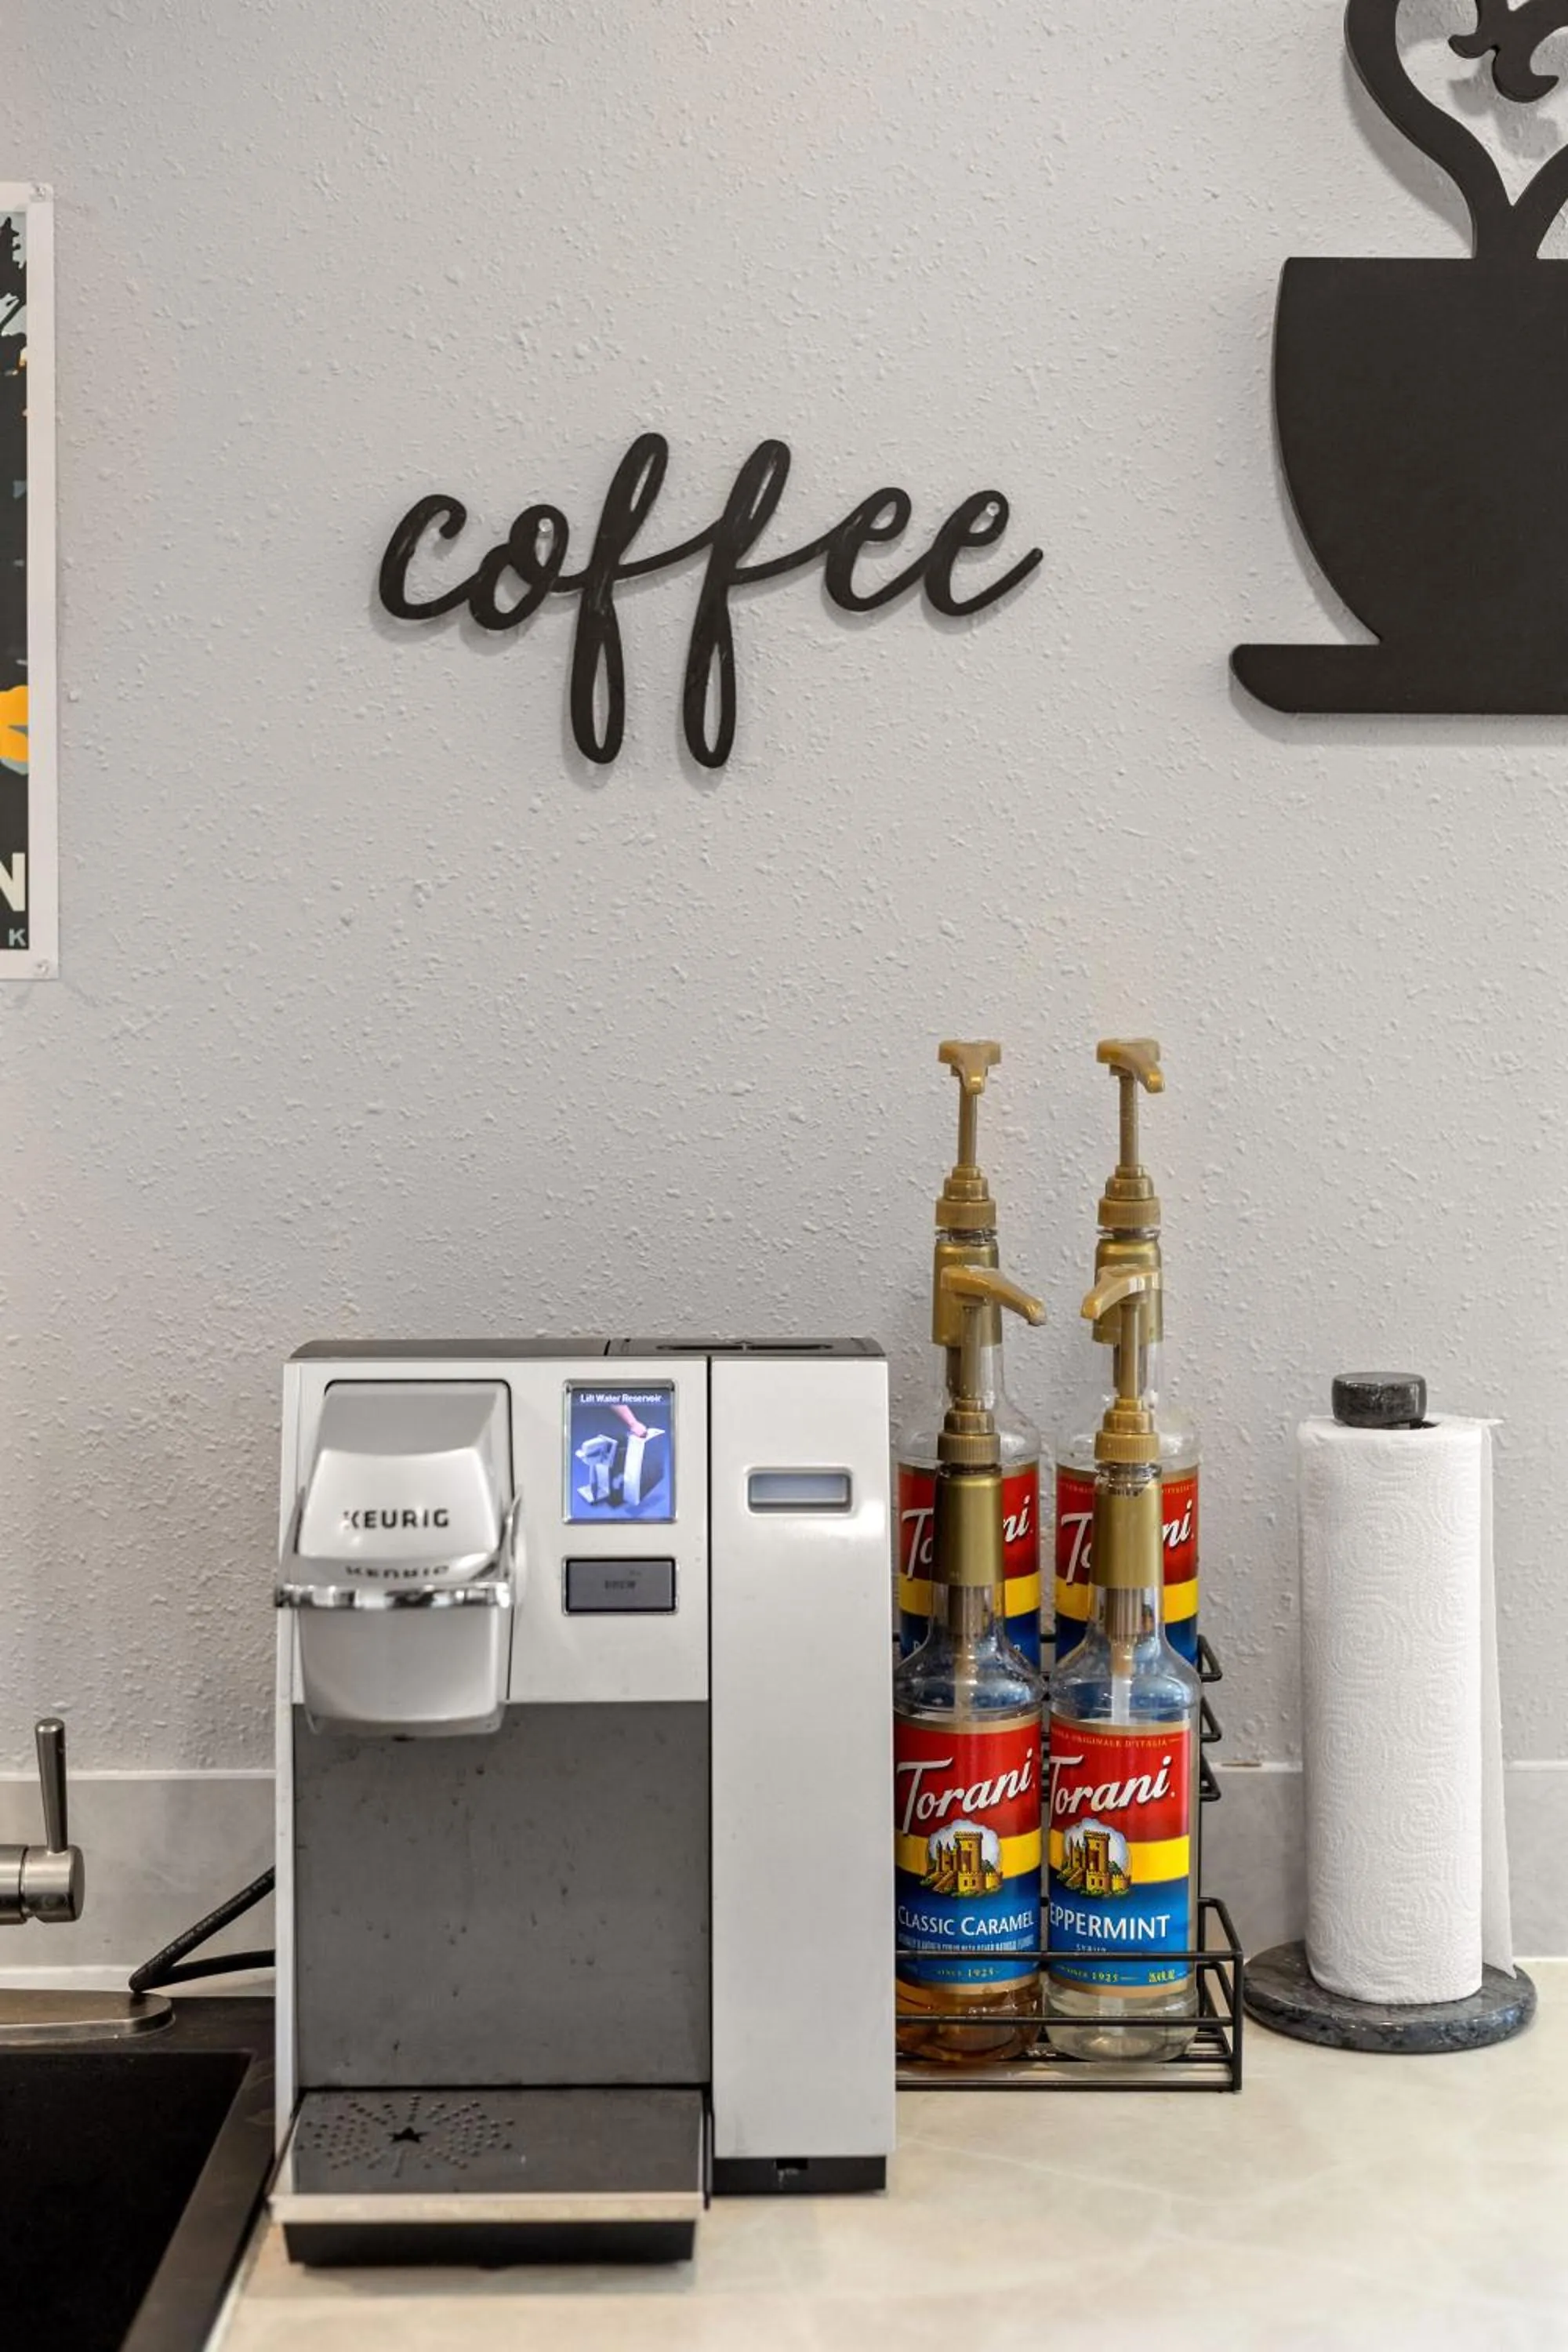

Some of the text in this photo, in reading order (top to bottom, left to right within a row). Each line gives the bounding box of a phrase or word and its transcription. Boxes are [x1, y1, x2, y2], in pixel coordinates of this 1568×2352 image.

[379, 433, 1044, 768] coffee
[9, 928, 26, 947] K
[596, 1393, 620, 1403] Water
[622, 1393, 662, 1403] Reservoir
[343, 1508, 449, 1529] KEURIG
[896, 1748, 1033, 1835] Torani
[1049, 1755, 1172, 1828] Torani
[898, 1906, 1034, 1936] CLASSIC CARAMEL
